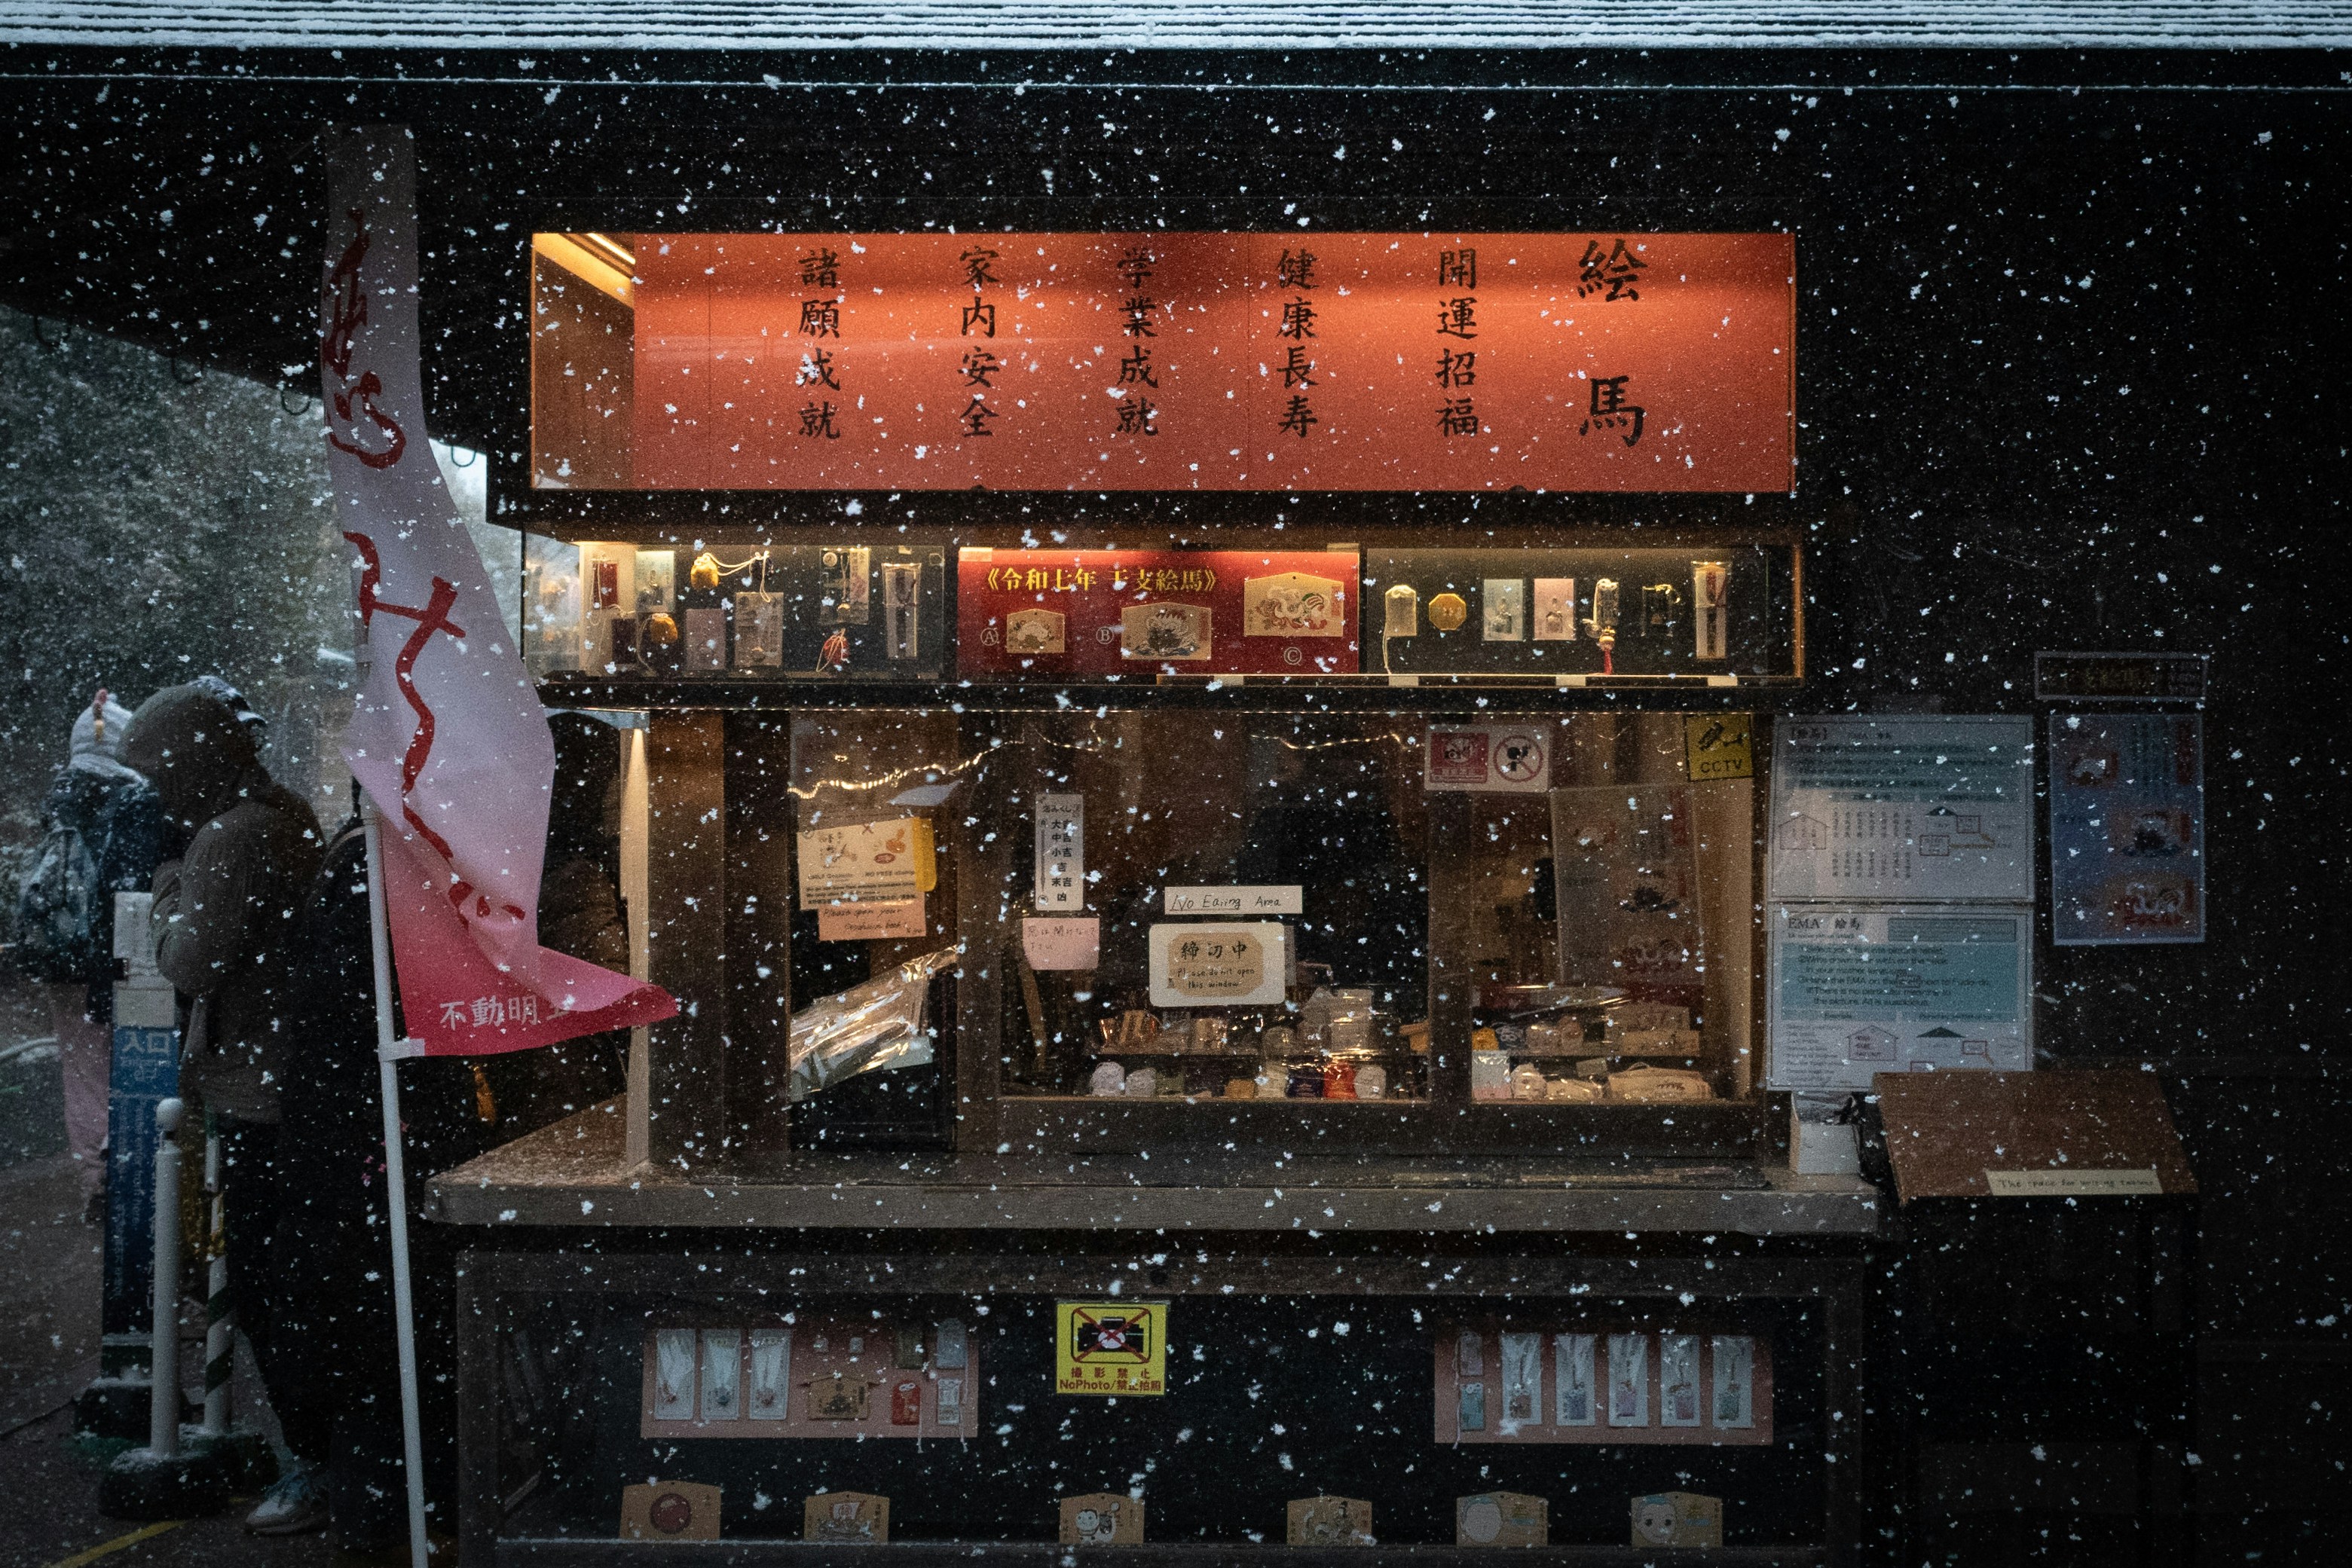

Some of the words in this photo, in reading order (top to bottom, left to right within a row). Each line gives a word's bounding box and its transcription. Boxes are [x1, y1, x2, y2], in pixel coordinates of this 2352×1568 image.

[797, 247, 840, 440] 諸願成就
[957, 245, 1000, 438] 家内安全
[1116, 247, 1160, 438] 学業成就
[1277, 247, 1319, 438] 健康長寿
[1436, 247, 1479, 438] 開運招福
[1577, 238, 1649, 448] 絵馬
[1700, 759, 1742, 774] CCTV
[1051, 847, 1072, 857] 小吉
[1051, 877, 1072, 888] 末吉
[1057, 892, 1067, 902] 凶
[1170, 894, 1194, 910] No
[1237, 968, 1256, 977] open
[1188, 980, 1204, 989] this
[439, 995, 569, 1032] 不動明
[121, 1031, 170, 1054] 入口
[1071, 1367, 1151, 1380] 撮影禁止
